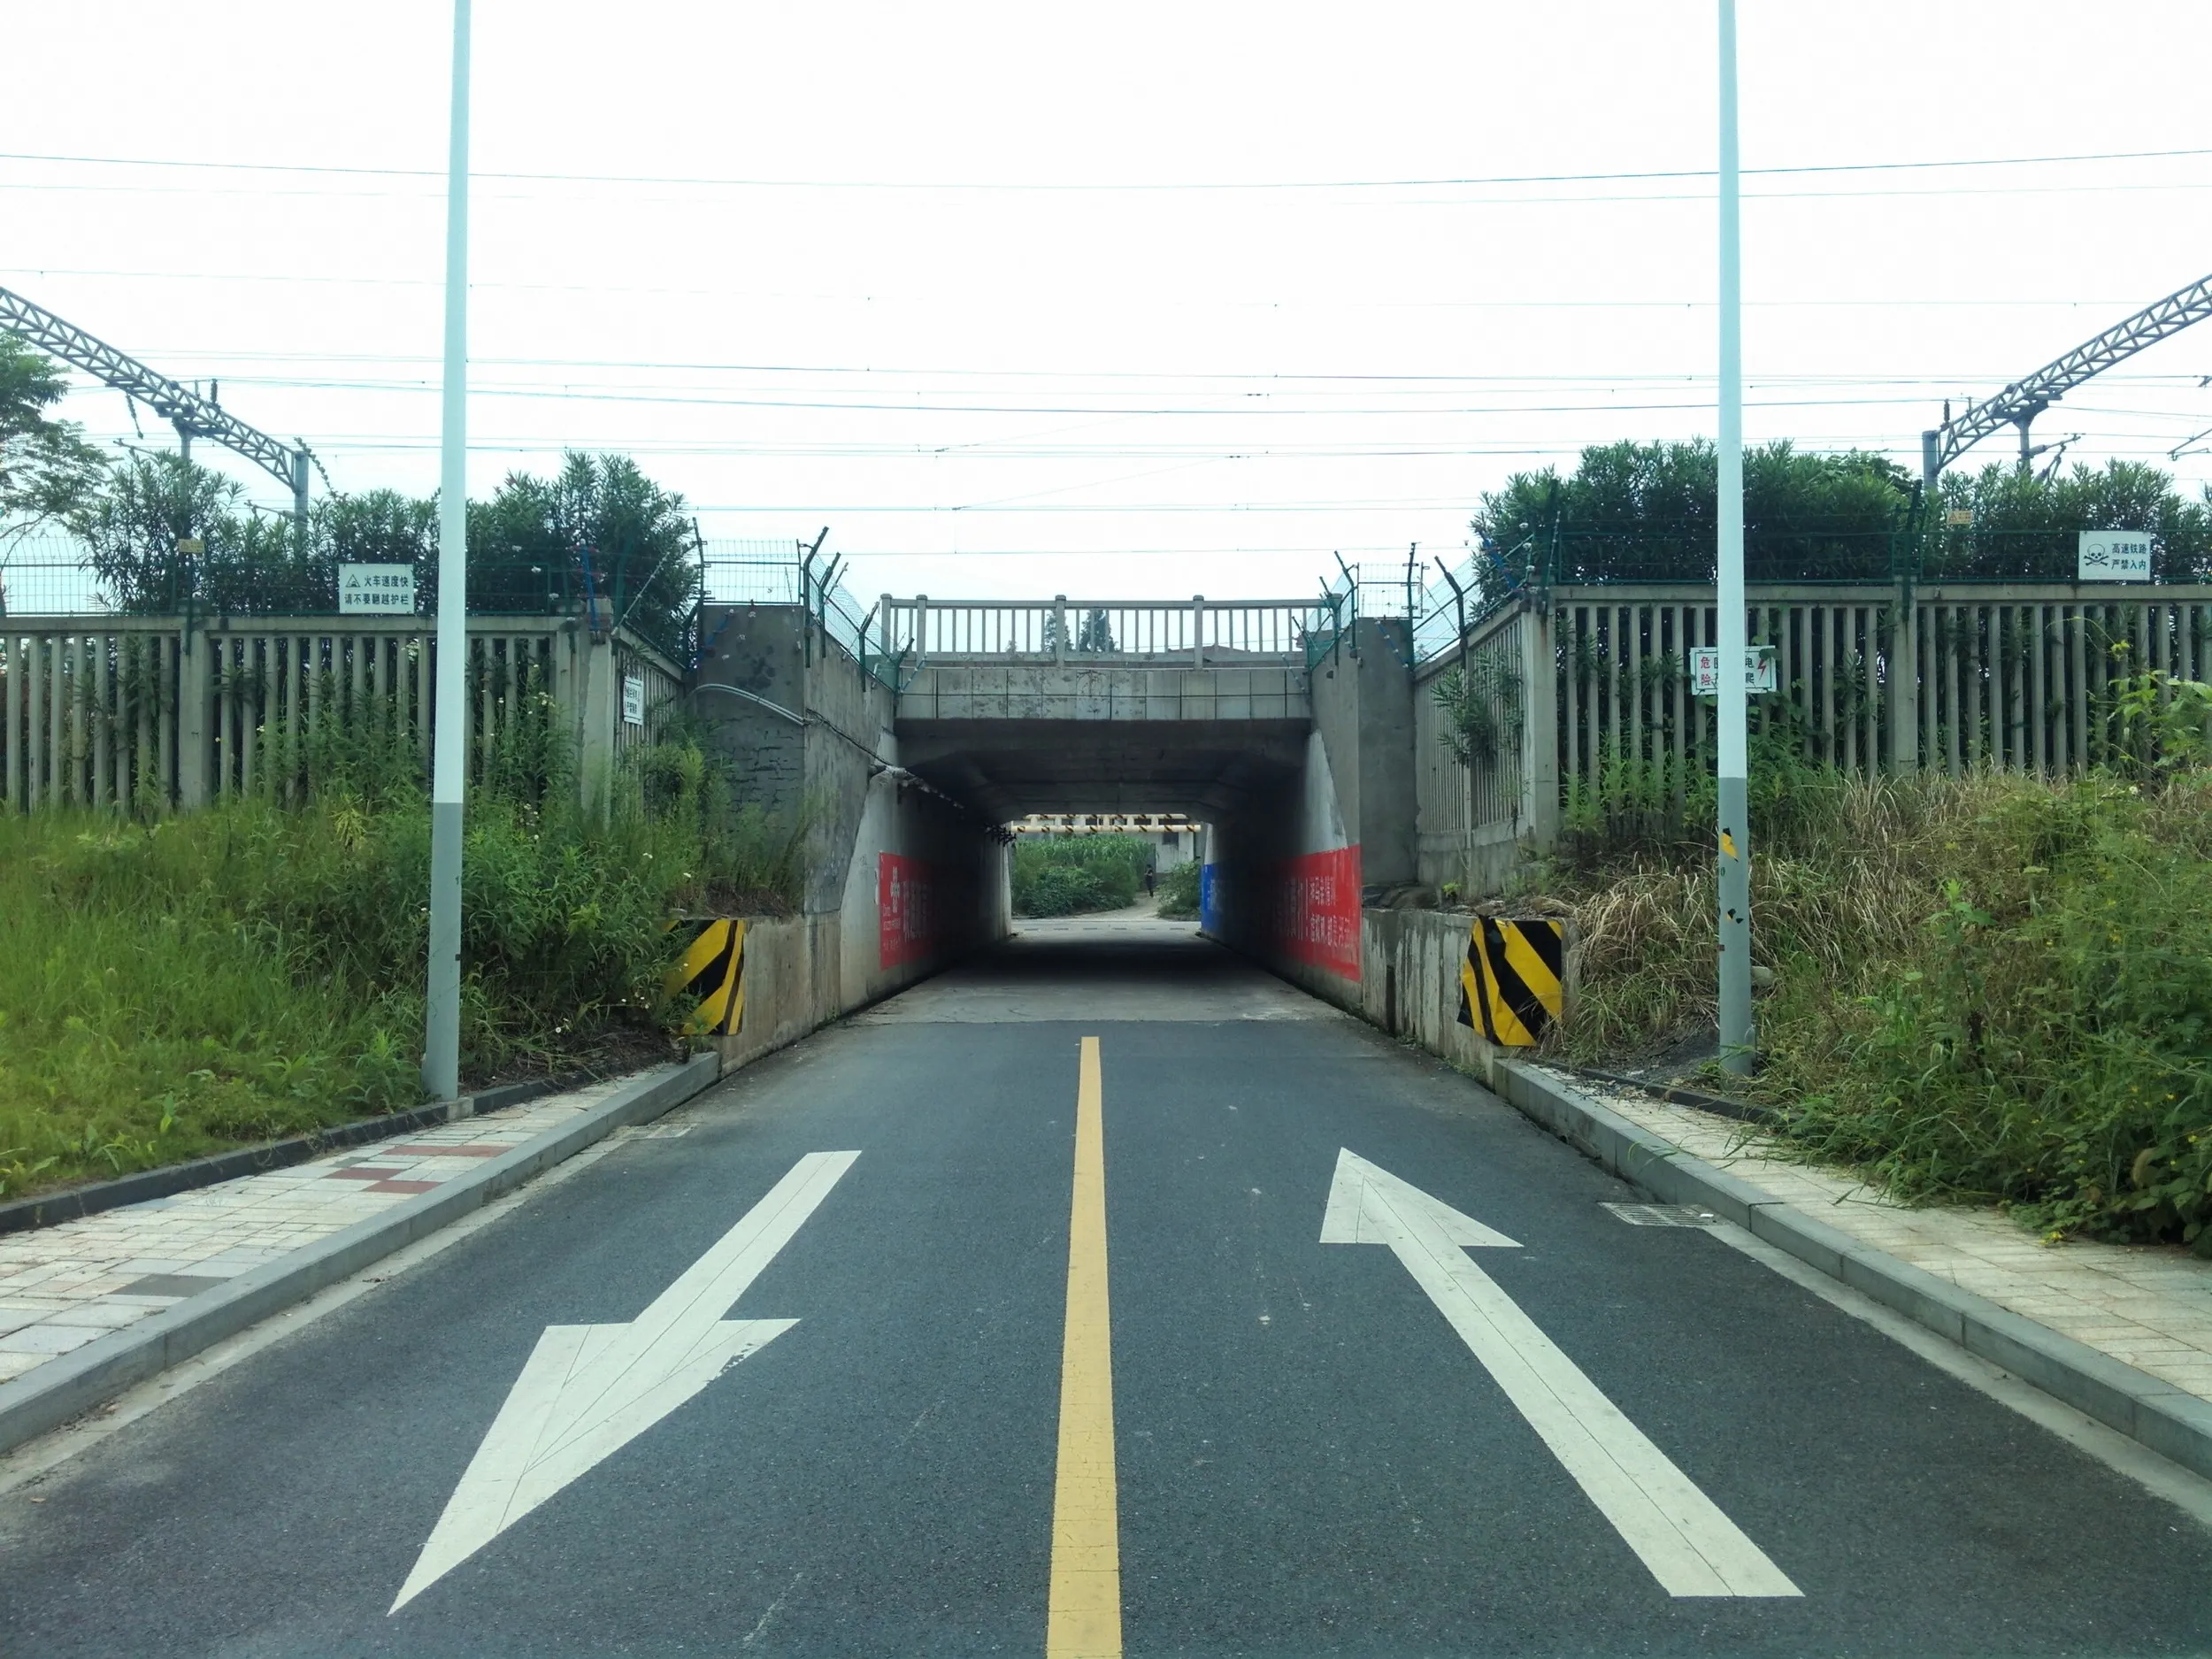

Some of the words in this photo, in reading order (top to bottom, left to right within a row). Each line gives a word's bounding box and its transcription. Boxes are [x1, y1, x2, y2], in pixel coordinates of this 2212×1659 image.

[2112, 542, 2147, 554] 高速铁路
[2111, 558, 2147, 571] 严禁入内
[364, 574, 409, 588] 火车速度快
